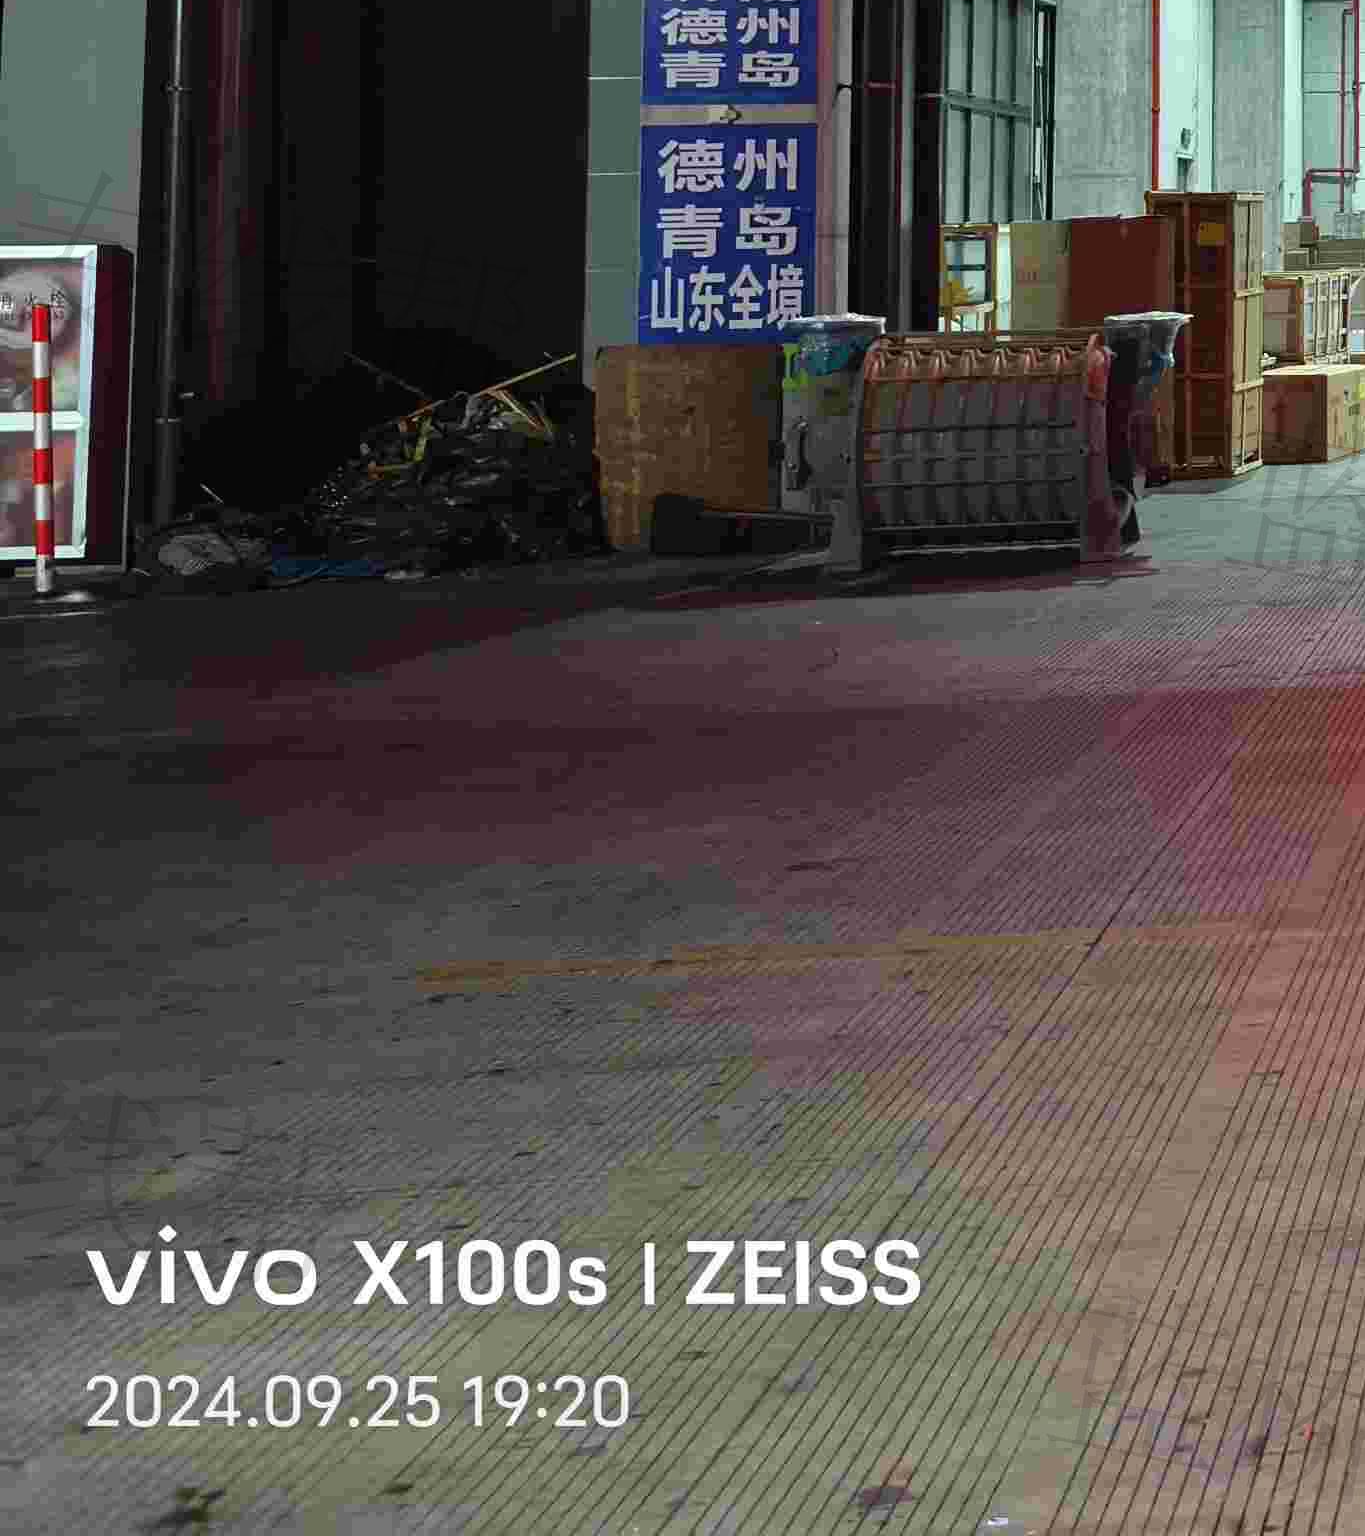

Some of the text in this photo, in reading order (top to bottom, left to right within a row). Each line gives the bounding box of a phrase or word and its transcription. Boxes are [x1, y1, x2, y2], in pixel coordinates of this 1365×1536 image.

[661, 7, 801, 46] 德州
[660, 50, 801, 89] 青岛
[658, 138, 798, 193] 德州
[657, 199, 799, 258] 青岛
[650, 263, 804, 333] 山东全境
